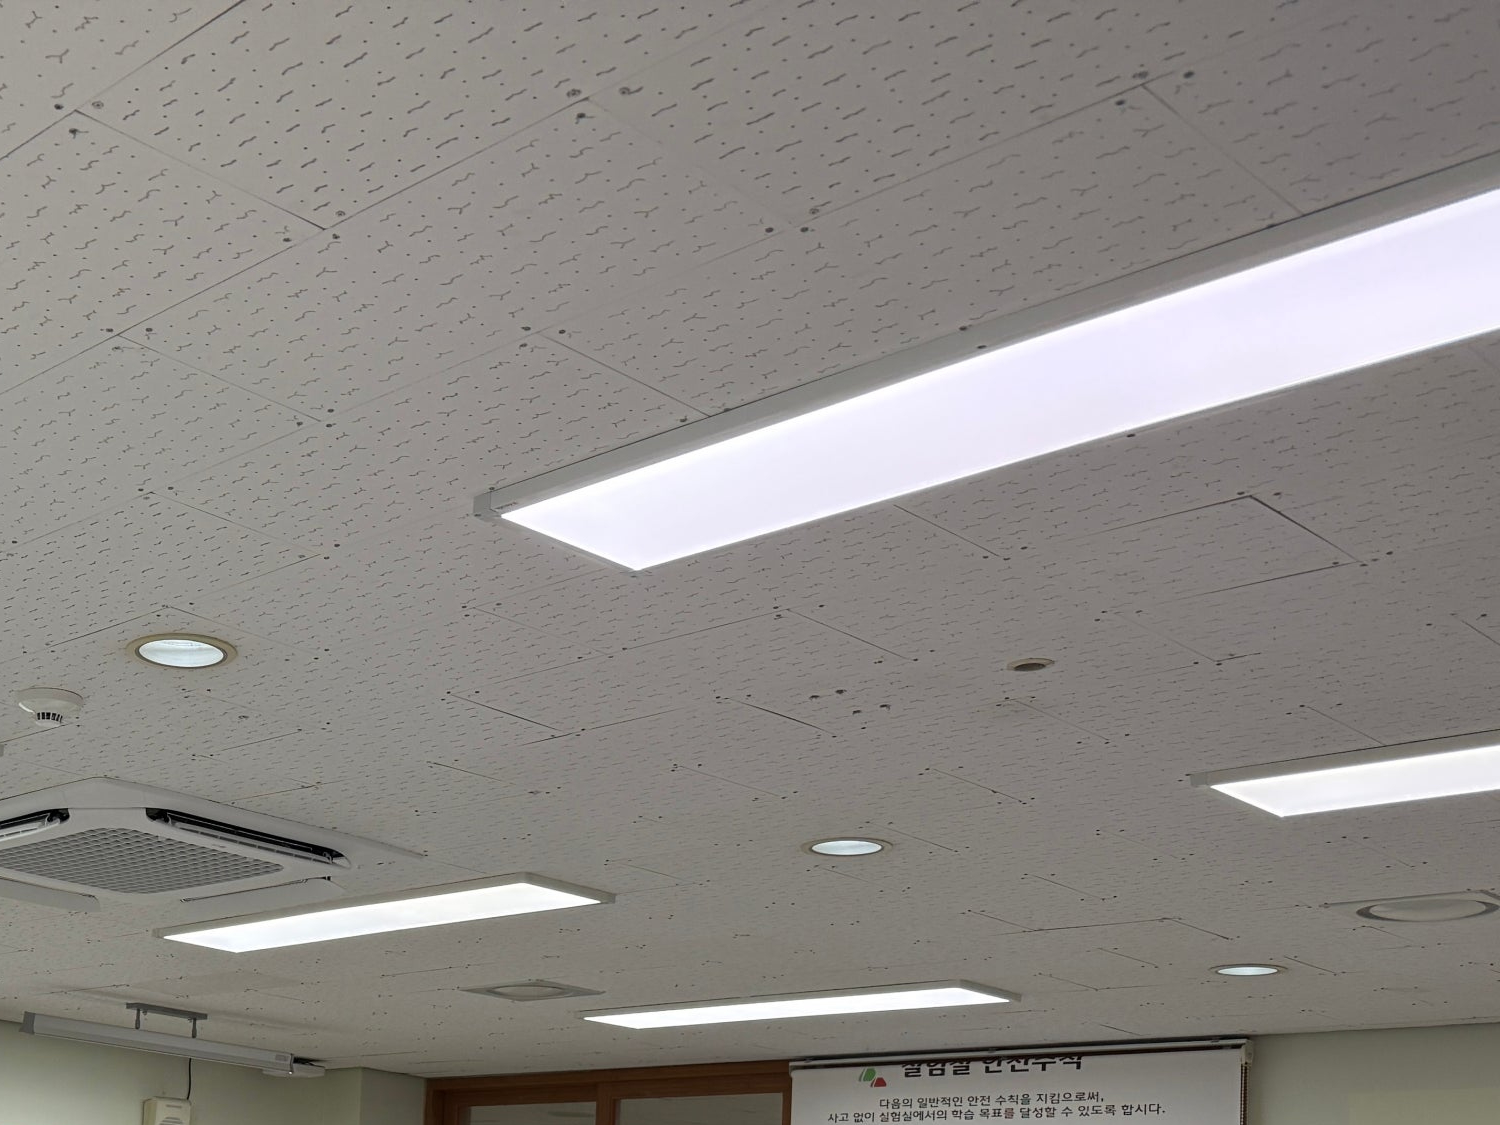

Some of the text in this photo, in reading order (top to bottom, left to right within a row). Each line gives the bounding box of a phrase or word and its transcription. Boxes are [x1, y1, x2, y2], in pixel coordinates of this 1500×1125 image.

[879, 1098, 913, 1110] 다음의
[916, 1096, 963, 1109] 일반적인
[967, 1095, 991, 1107] 안전
[994, 1093, 1032, 1106] 수칙을
[827, 1103, 1166, 1124] 사고 없이 실험실에서의 학습 목표를 달성할 수 있도록 합시다.
